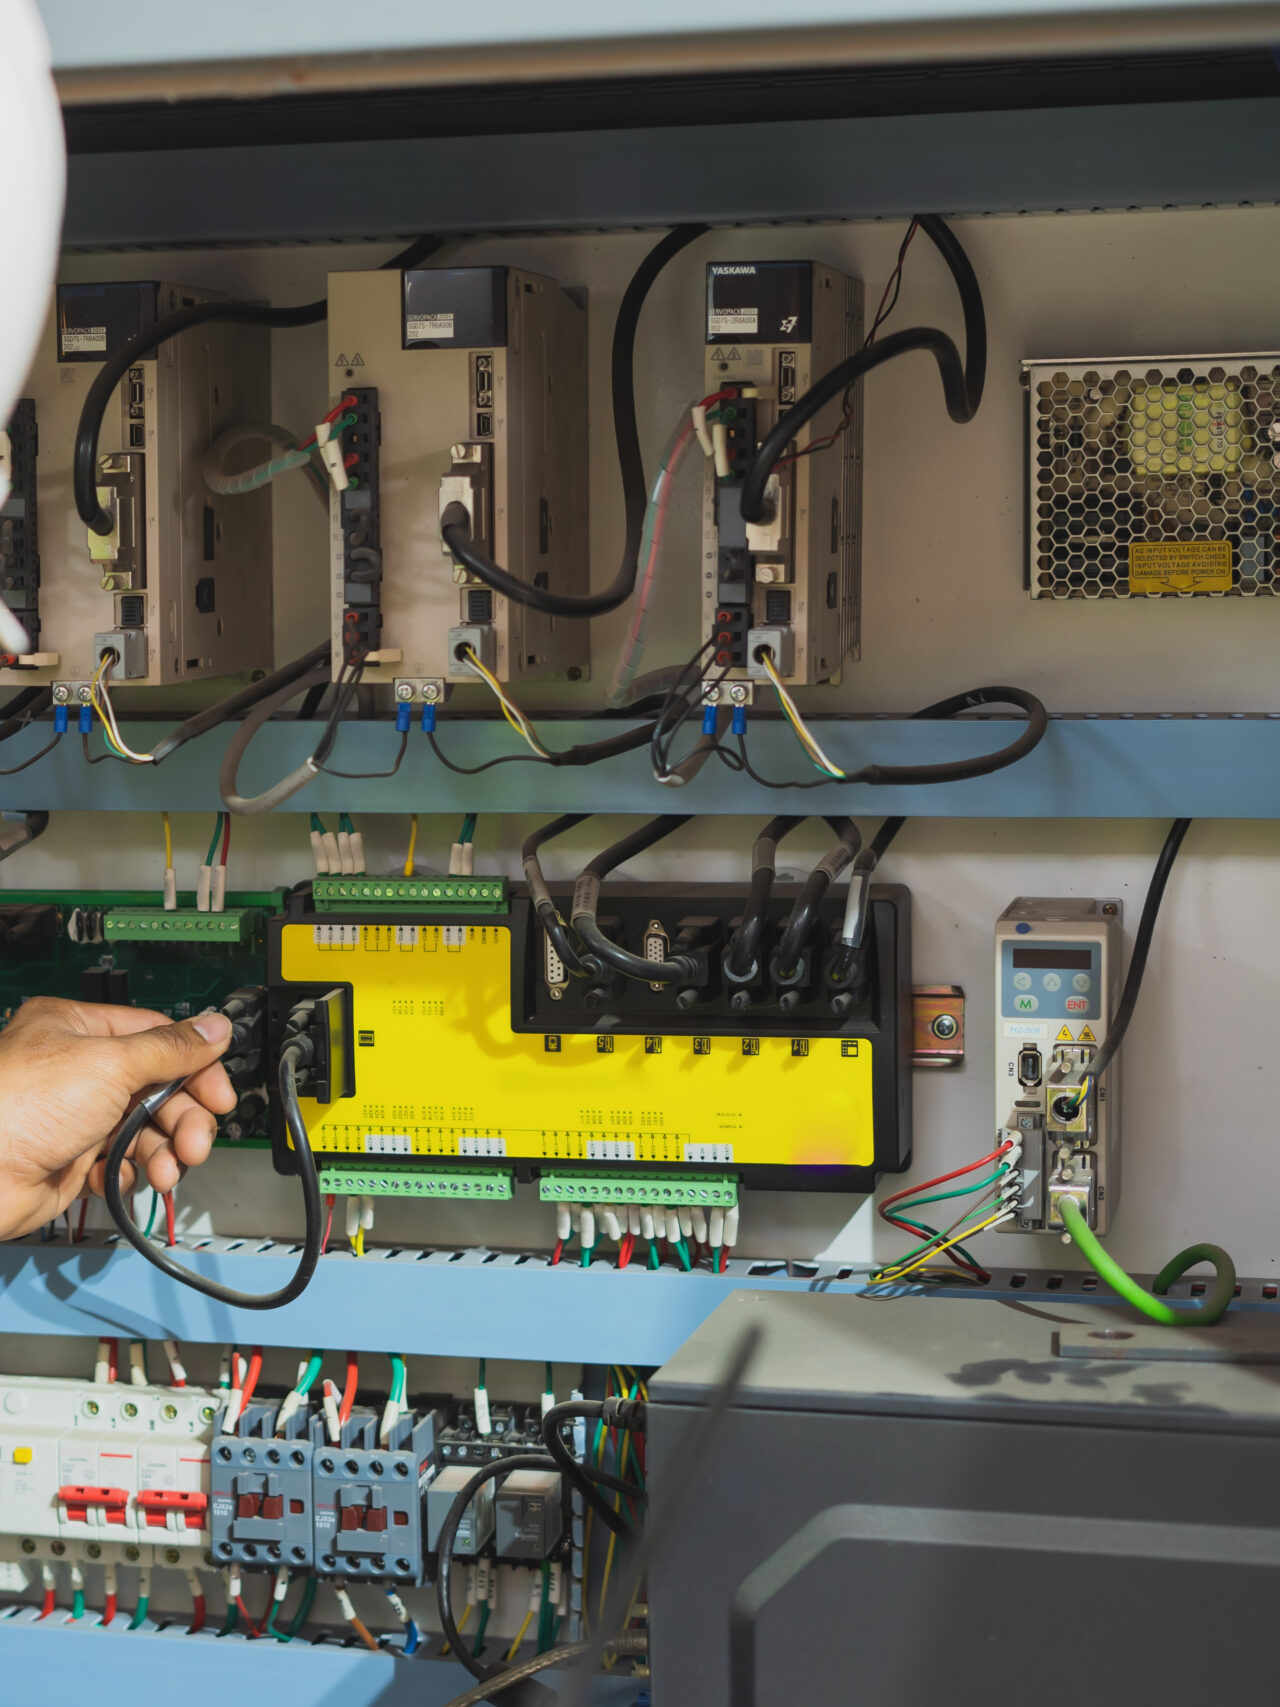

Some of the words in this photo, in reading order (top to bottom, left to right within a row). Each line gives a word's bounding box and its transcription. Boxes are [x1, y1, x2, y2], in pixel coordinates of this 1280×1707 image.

[712, 266, 756, 275] YASKAWA
[1135, 554, 1167, 562] SELECTED
[1191, 560, 1227, 568] AVOIDING
[1020, 999, 1032, 1009] M
[1067, 1000, 1086, 1010] ENT
[598, 1037, 604, 1048] 5
[646, 1038, 652, 1049] 4
[694, 1038, 700, 1049] 3
[743, 1039, 749, 1050] 2
[793, 1039, 799, 1051] 1
